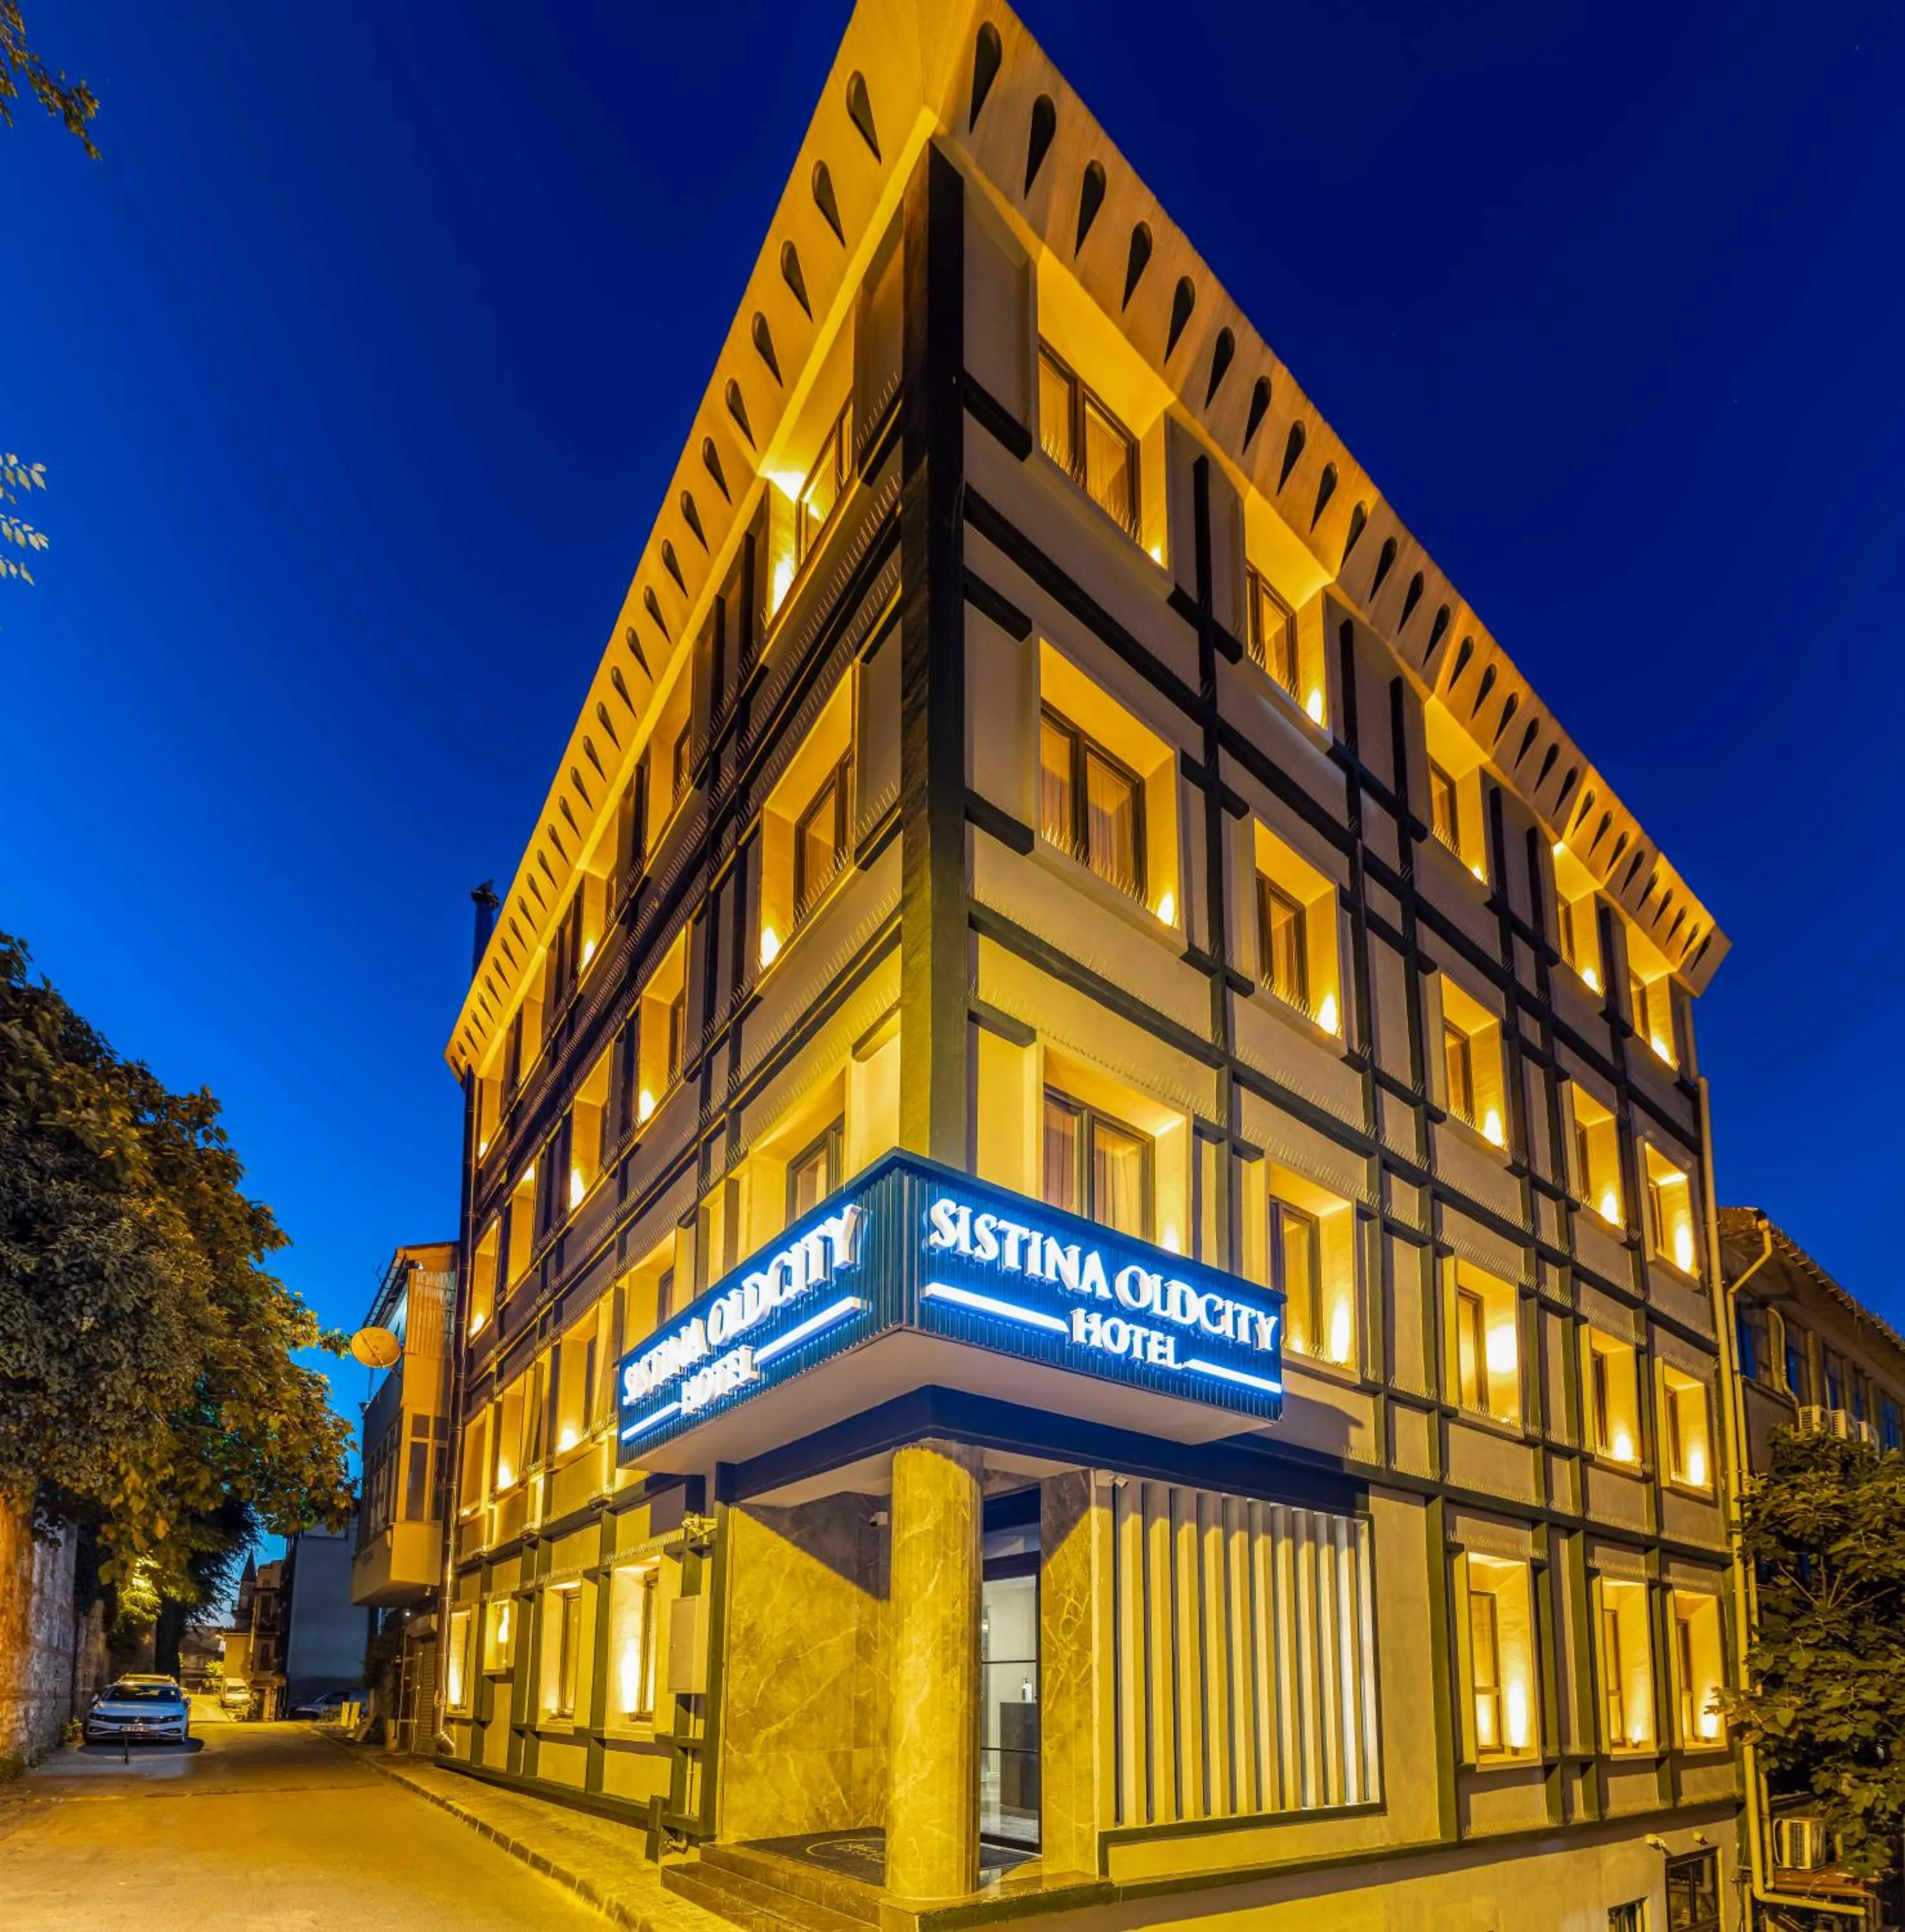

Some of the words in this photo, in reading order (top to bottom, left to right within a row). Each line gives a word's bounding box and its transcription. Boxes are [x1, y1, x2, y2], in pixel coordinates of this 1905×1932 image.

[708, 1203, 862, 1346] OLDCITY
[929, 1198, 1112, 1300] SISTINA
[1115, 1264, 1278, 1352] OLDCITY
[681, 1345, 759, 1416] HOTEL
[1068, 1307, 1184, 1370] HOTEL
